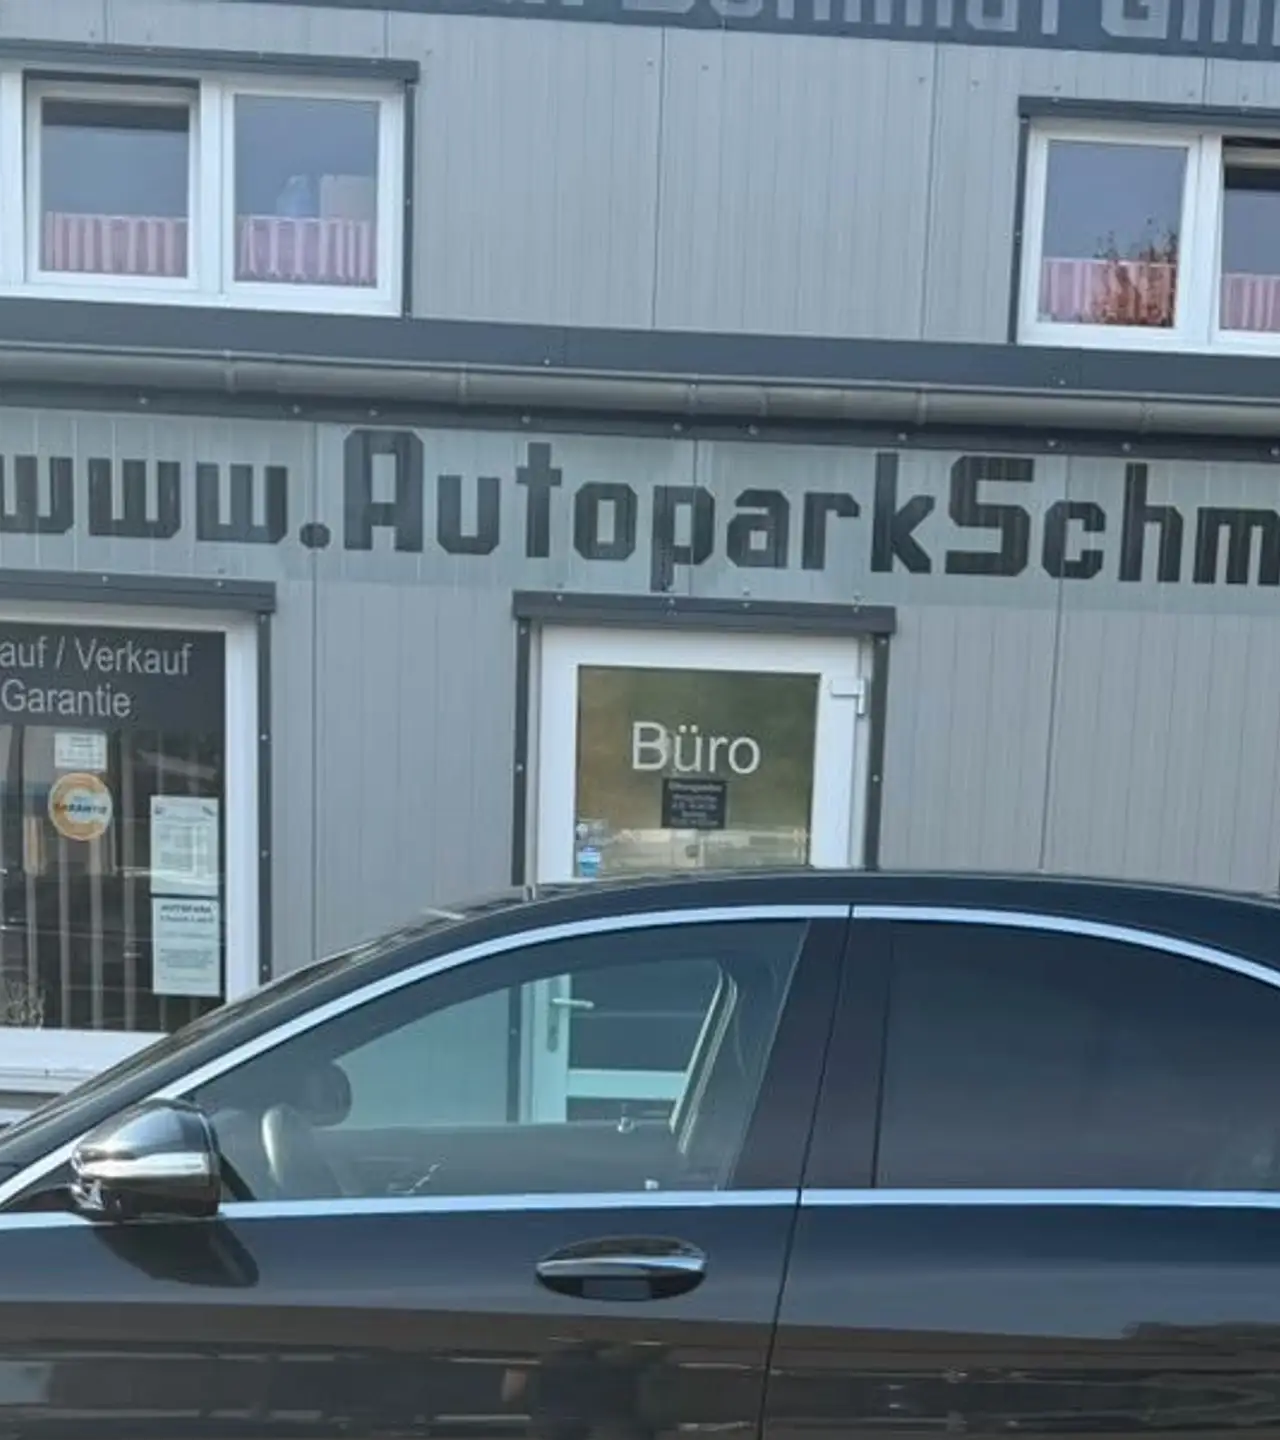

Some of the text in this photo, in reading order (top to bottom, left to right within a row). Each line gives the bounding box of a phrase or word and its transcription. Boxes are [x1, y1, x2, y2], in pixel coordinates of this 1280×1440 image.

[74, 639, 193, 676] Verkauf
[1, 679, 132, 718] Garantie
[632, 721, 761, 774] Büro
